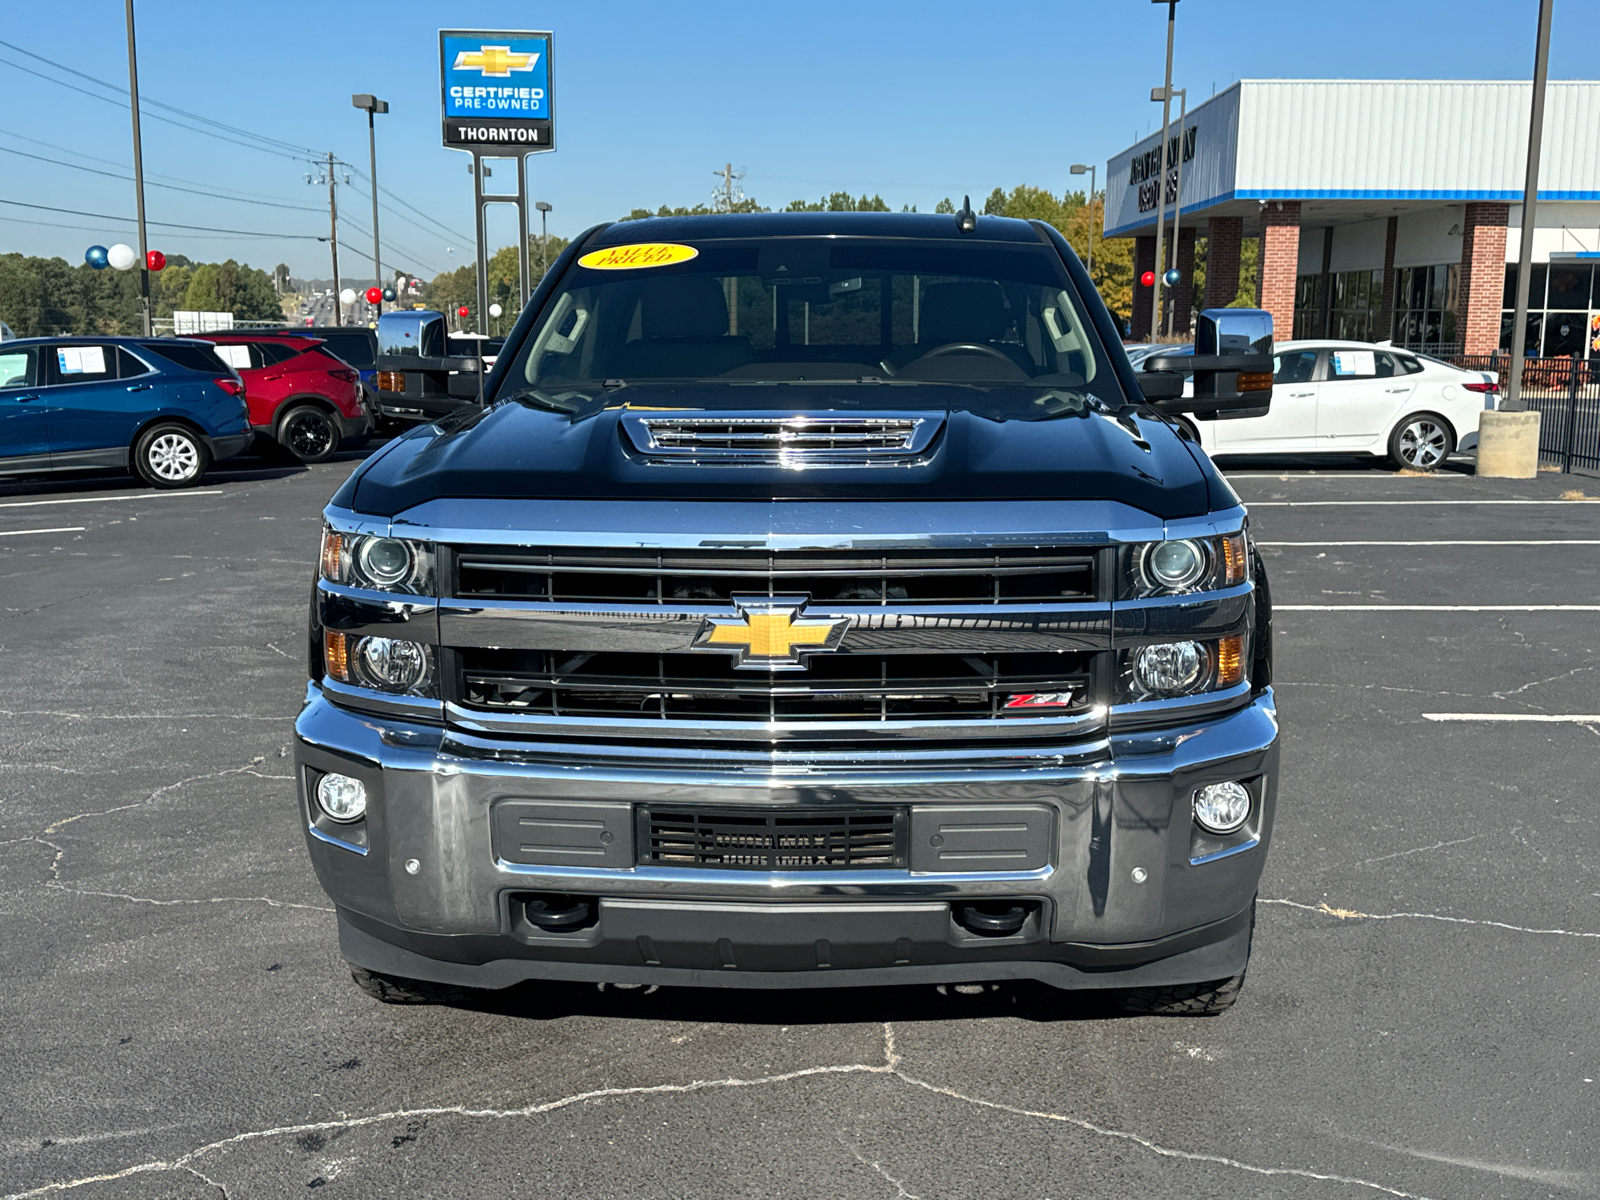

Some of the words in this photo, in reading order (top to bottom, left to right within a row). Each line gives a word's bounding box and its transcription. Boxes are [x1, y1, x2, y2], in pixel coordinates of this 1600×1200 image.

[450, 86, 545, 99] CERTIFIED
[455, 98, 540, 110] PRE-OWNED
[458, 127, 538, 141] THORNTON
[1147, 126, 1198, 178] THONTON
[1138, 180, 1157, 213] USED
[1156, 170, 1178, 208] CRS
[610, 246, 675, 257] VALUE
[595, 253, 673, 266] PRICED
[1003, 692, 1073, 708] Z71
[716, 832, 827, 850] DURAMAX
